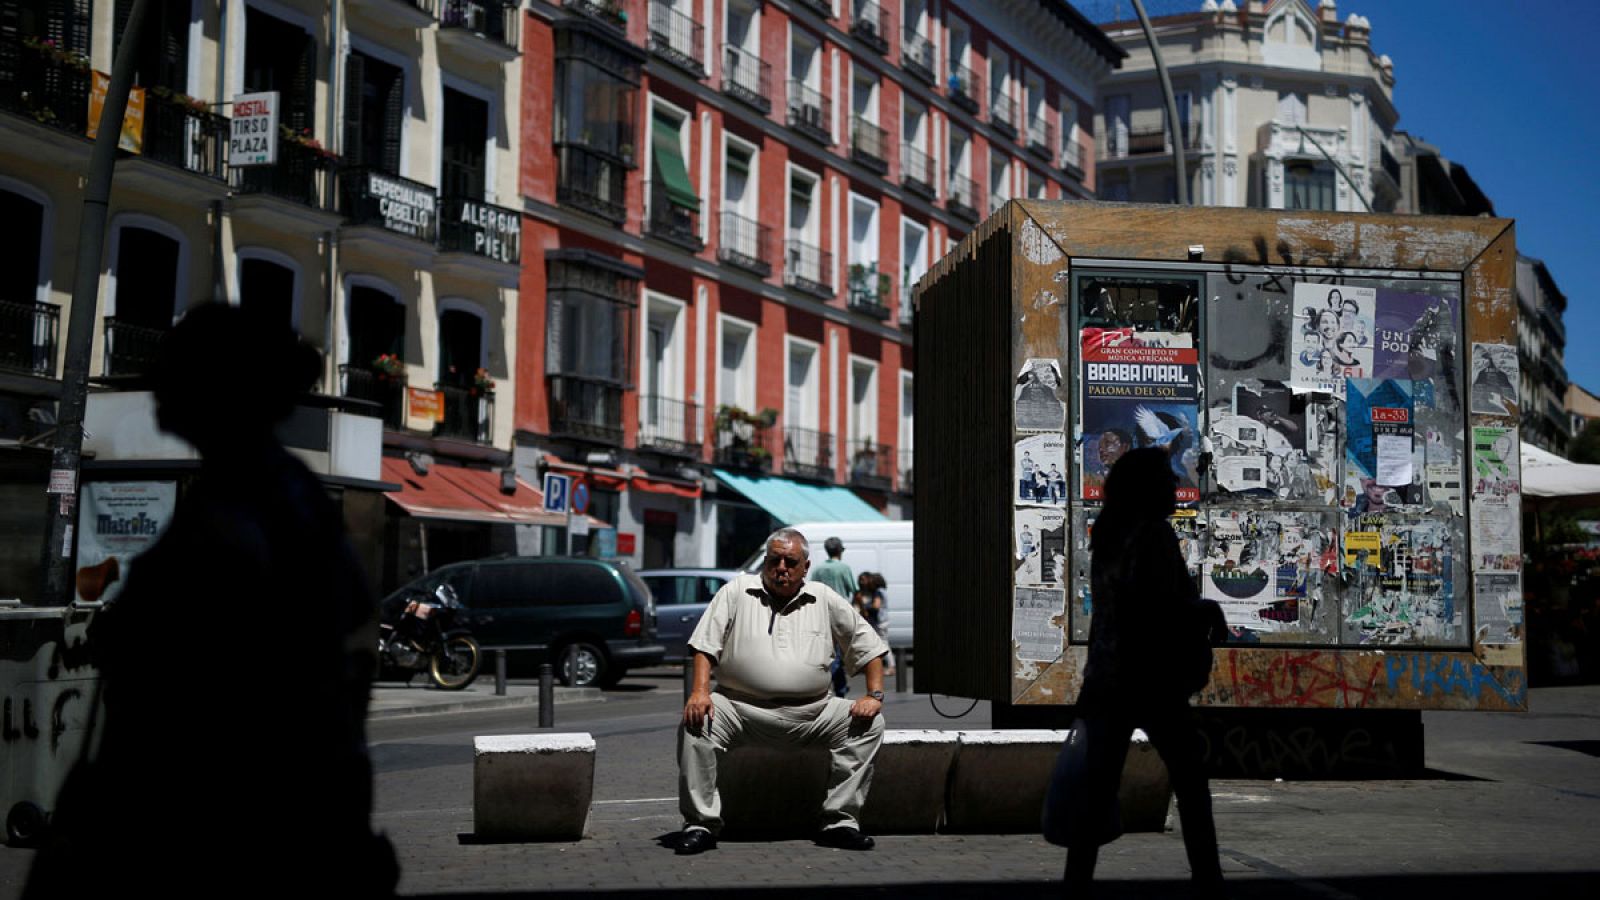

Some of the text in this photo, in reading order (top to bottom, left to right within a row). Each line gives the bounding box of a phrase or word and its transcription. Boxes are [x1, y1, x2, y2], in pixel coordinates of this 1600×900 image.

[233, 100, 270, 117] HOSTAL
[233, 117, 268, 134] TIRSO
[231, 136, 269, 154] PLAZA
[370, 175, 436, 213] ESPECIALISTA
[379, 198, 430, 228] CABELLO
[461, 201, 521, 234] ALERGIA
[475, 231, 511, 263] PIEL
[1138, 355, 1174, 363] AFRICANA
[1087, 363, 1189, 382] BAABA MAAL
[1088, 385, 1177, 397] PALOMA DEL SOL
[549, 477, 562, 509] P
[1089, 488, 1100, 497] 24
